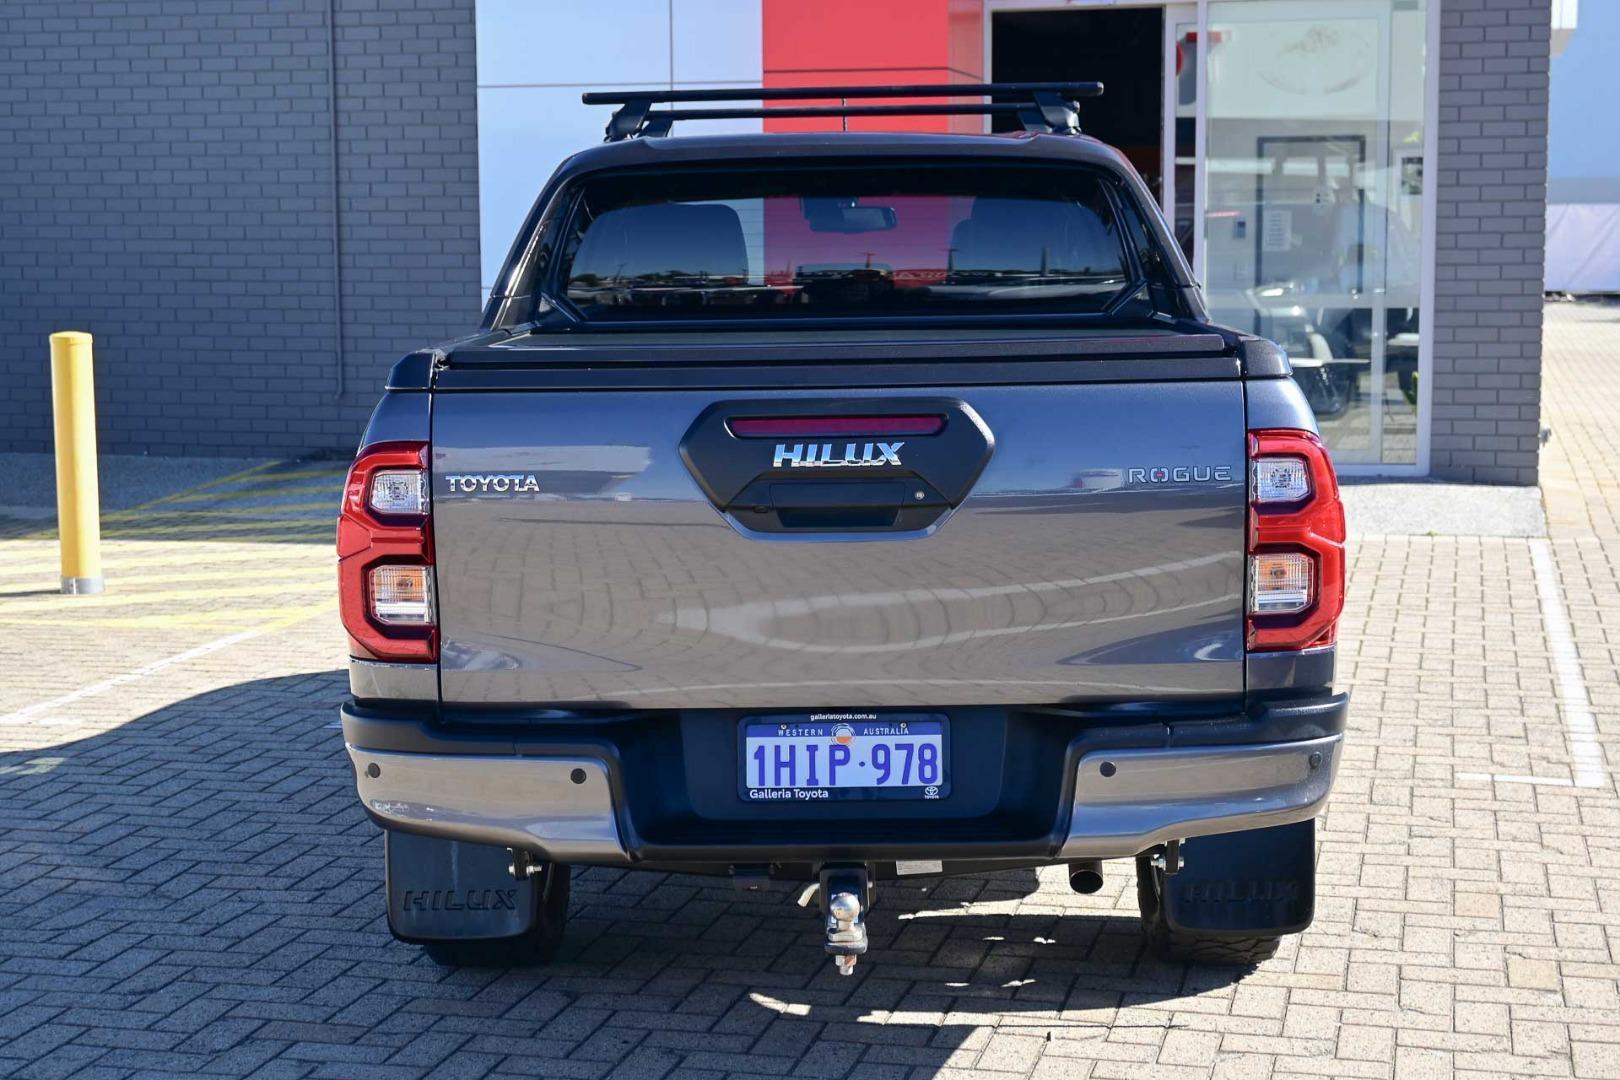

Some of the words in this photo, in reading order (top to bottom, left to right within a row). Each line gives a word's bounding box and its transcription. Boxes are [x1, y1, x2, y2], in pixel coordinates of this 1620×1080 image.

[773, 441, 905, 468] HILUX
[445, 474, 540, 492] TOYOTA
[1128, 466, 1232, 483] ROGUE
[810, 713, 877, 721] galleriatoyota.com.au
[778, 728, 823, 737] WESTERN
[863, 727, 909, 736] AUSTRALIA
[749, 788, 791, 800] Galleria
[793, 788, 829, 801] Toyota
[403, 889, 519, 912] HILUX
